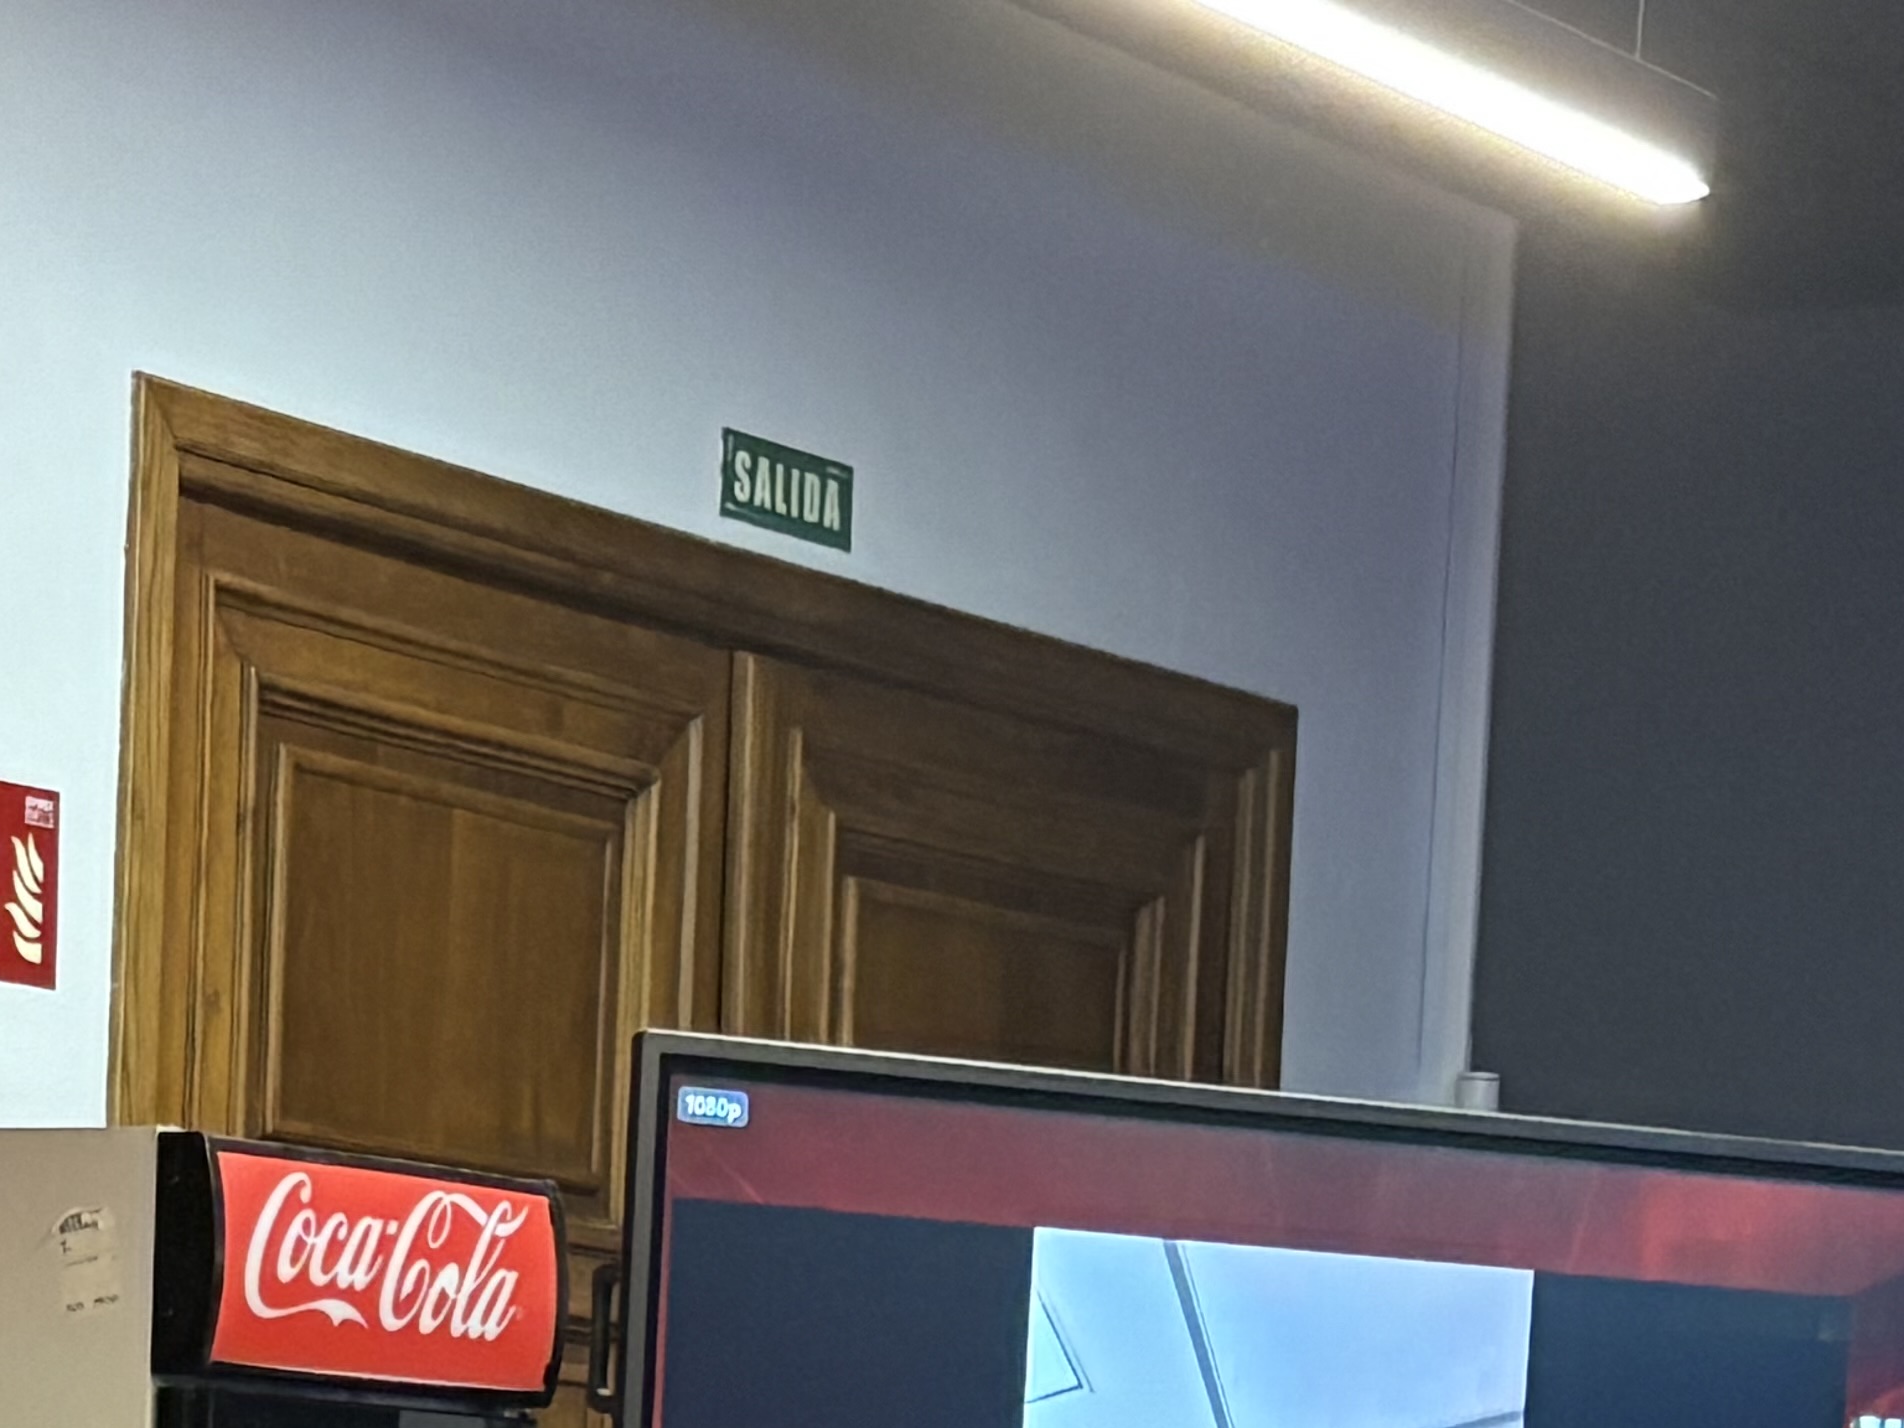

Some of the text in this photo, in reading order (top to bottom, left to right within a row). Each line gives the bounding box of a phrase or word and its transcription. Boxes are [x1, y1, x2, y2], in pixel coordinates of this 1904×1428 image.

[733, 449, 841, 532] SALIDA
[684, 1093, 742, 1125] 1080p
[244, 1171, 528, 1341] Coca-Cola
